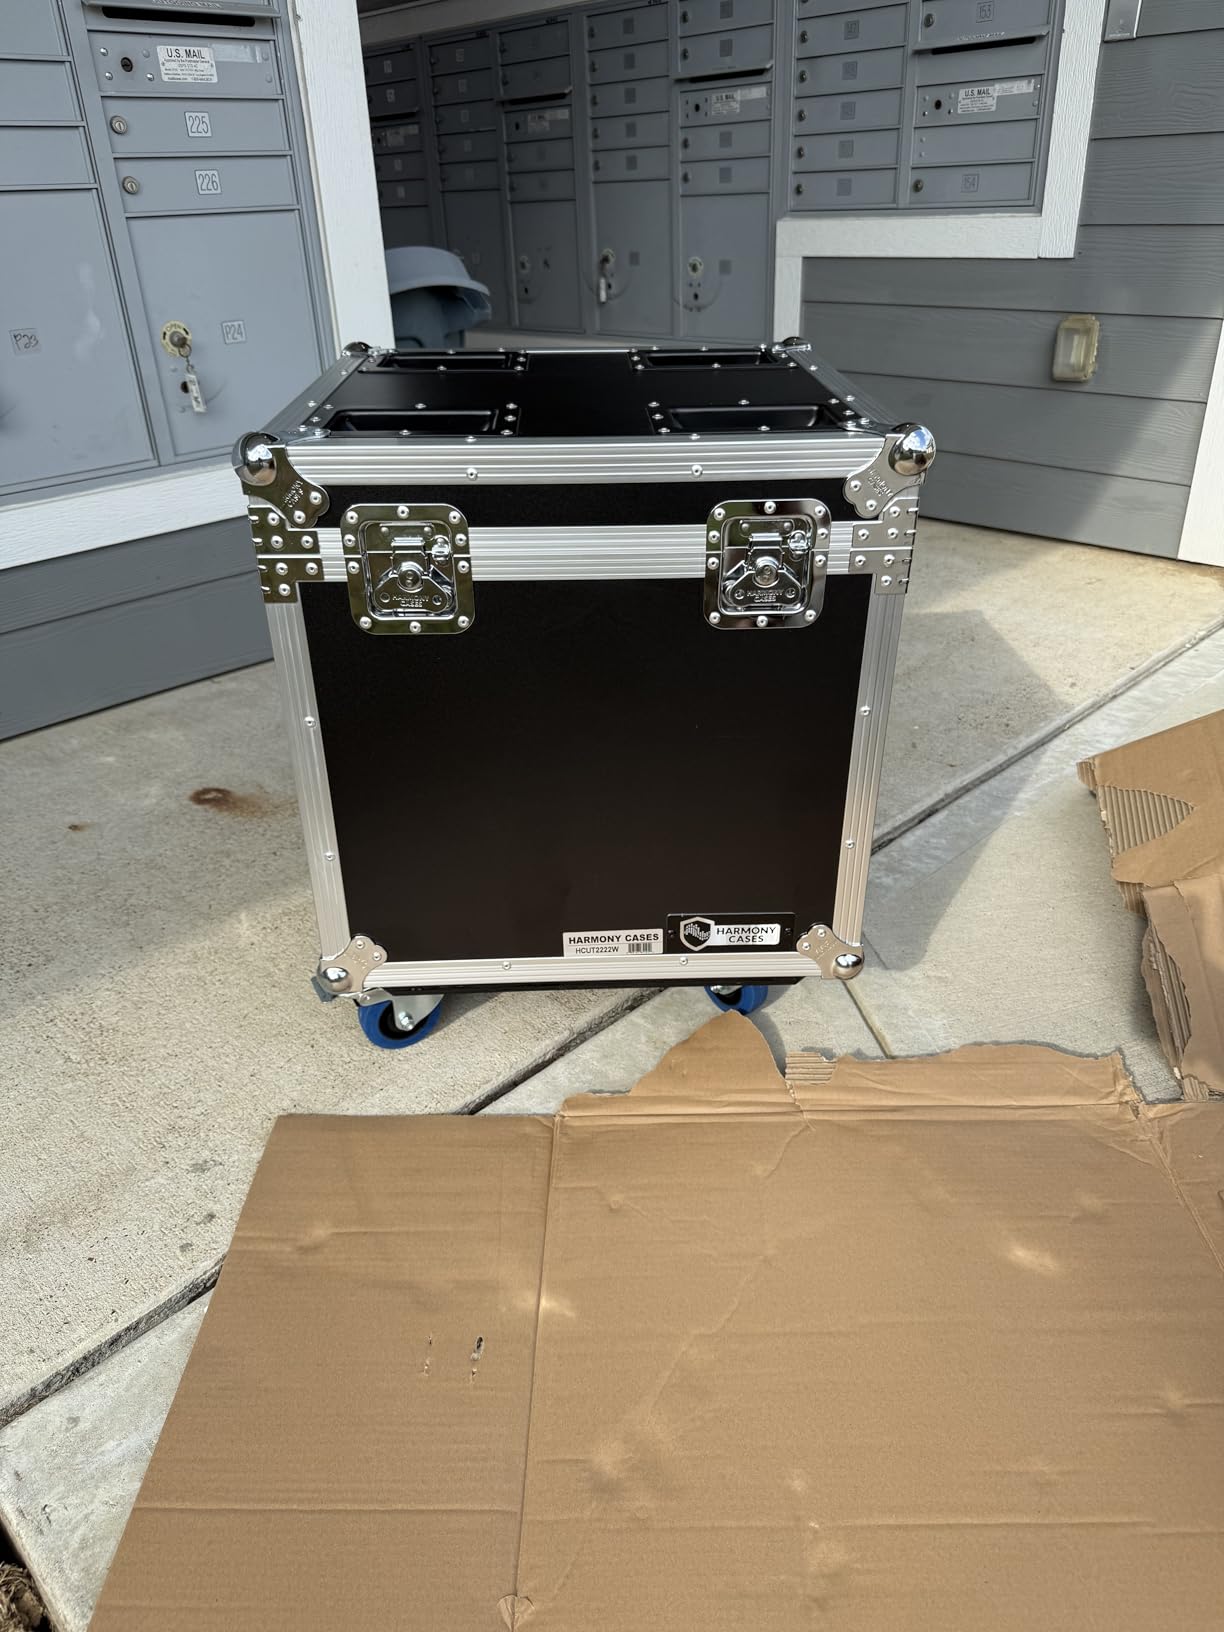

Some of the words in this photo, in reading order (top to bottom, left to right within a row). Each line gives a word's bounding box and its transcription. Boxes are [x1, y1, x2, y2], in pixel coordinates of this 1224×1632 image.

[166, 48, 184, 58] U.S.
[185, 49, 205, 59] MAIL
[964, 89, 975, 97] U.S.
[977, 88, 990, 96] MAIL
[188, 115, 209, 134] 225
[198, 173, 219, 191] 226
[224, 323, 244, 341] P24
[716, 926, 777, 935] HARMONY
[568, 934, 622, 944] HARMONY
[624, 933, 659, 942] CASES
[728, 935, 764, 943] CASES
[575, 946, 619, 954] HCUT2222W
